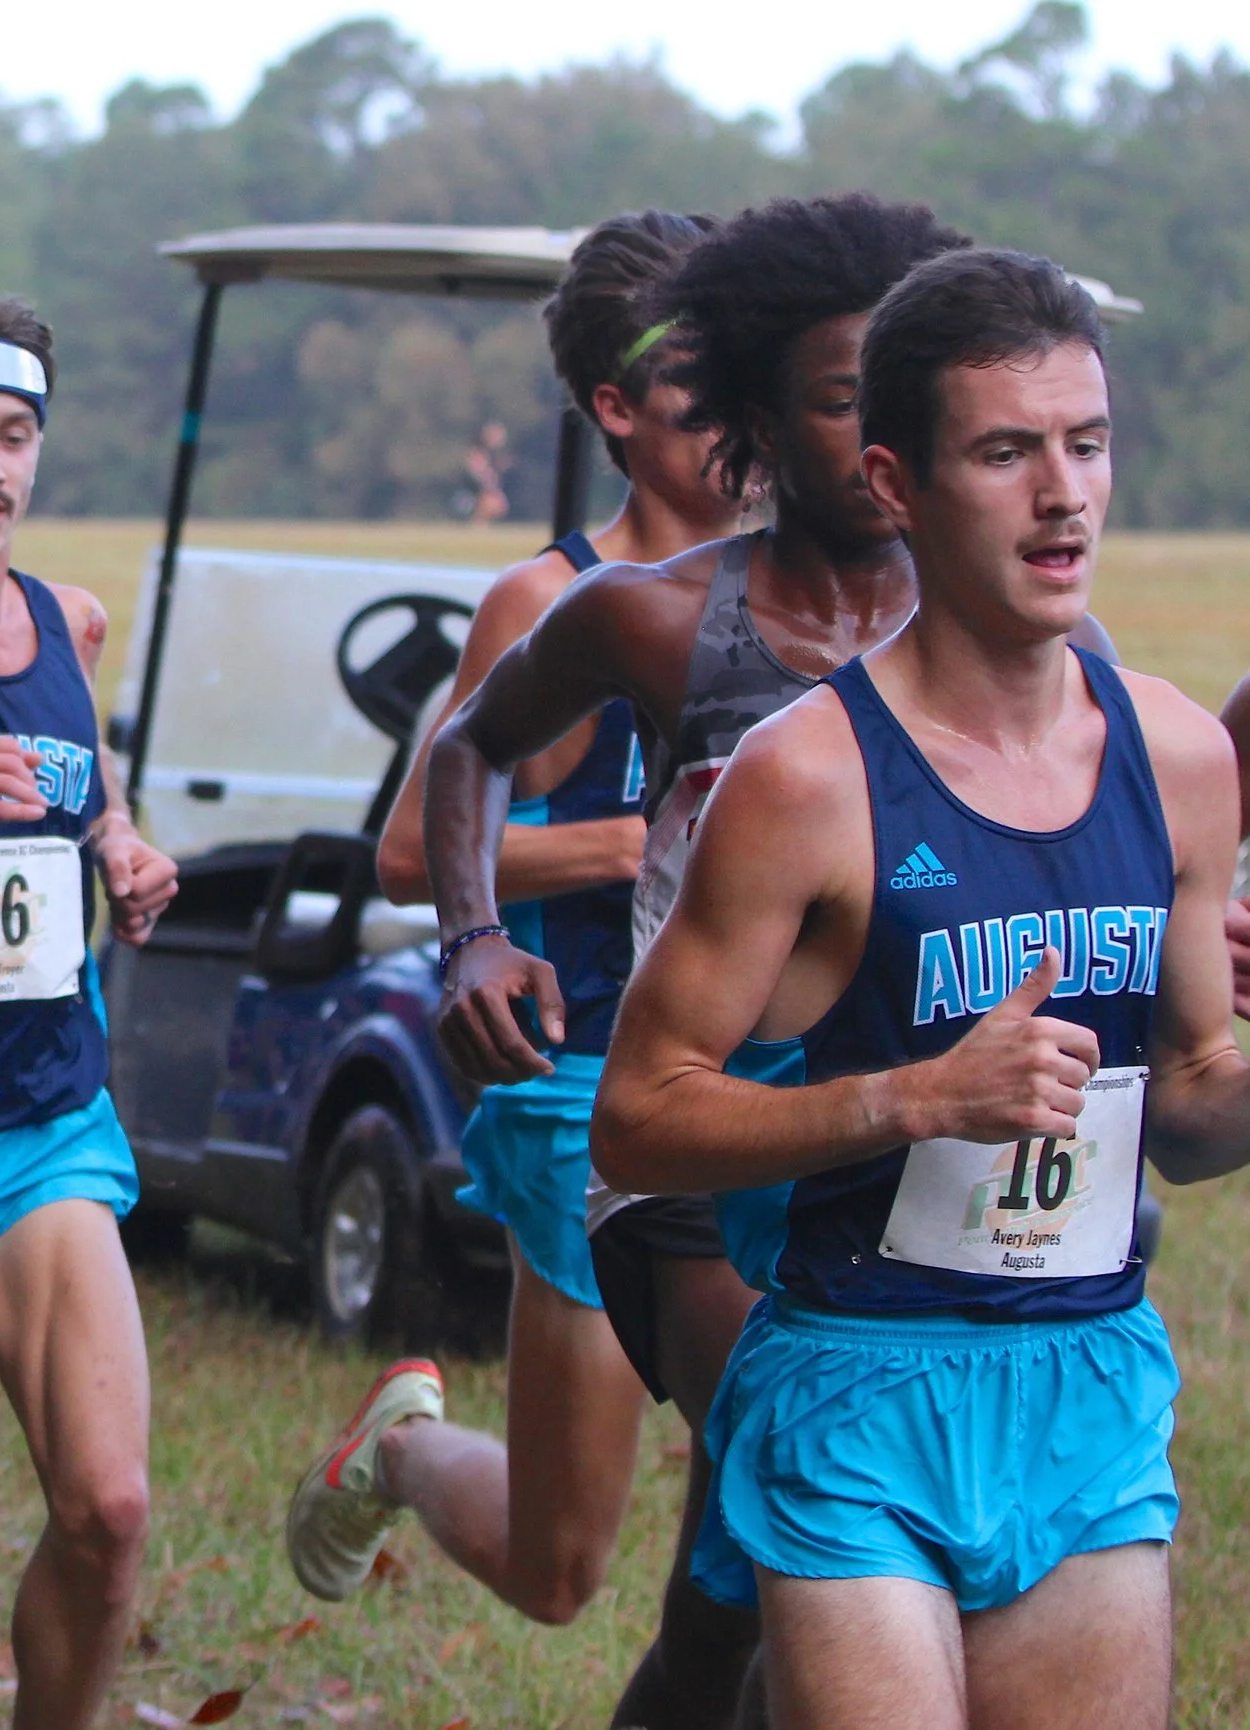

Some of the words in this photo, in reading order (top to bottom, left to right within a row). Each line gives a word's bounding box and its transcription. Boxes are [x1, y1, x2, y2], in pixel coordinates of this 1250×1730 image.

[890, 870, 958, 889] adidas
[997, 1133, 1075, 1211] 16
[991, 1229, 1023, 1249] Avery
[1026, 1229, 1062, 1249] Jaynes
[1001, 1251, 1046, 1270] Augusta
